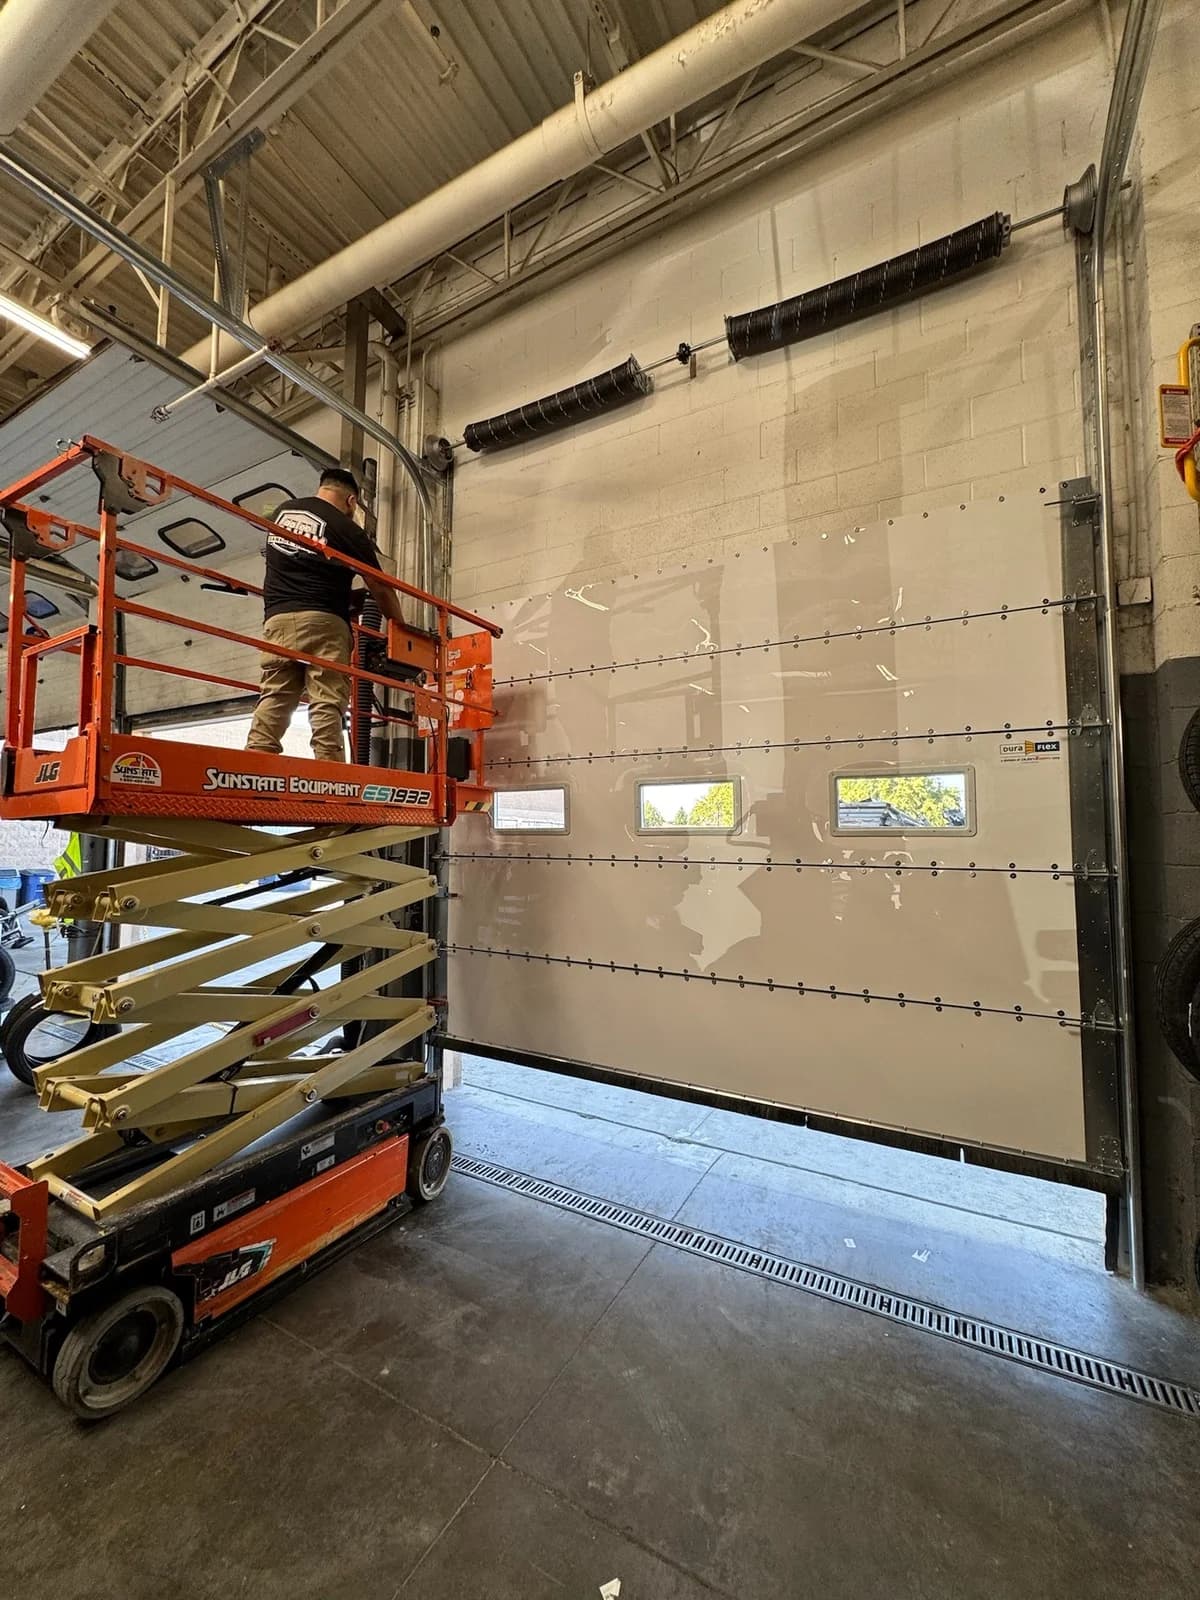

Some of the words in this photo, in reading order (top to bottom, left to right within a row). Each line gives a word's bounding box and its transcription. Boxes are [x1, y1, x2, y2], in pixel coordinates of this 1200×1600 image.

[34, 760, 61, 784] JLG
[203, 768, 286, 792] SUNSTATE
[289, 776, 361, 797] EQUIPMENT
[363, 785, 431, 805] ES1932
[218, 1259, 253, 1292] JLG
